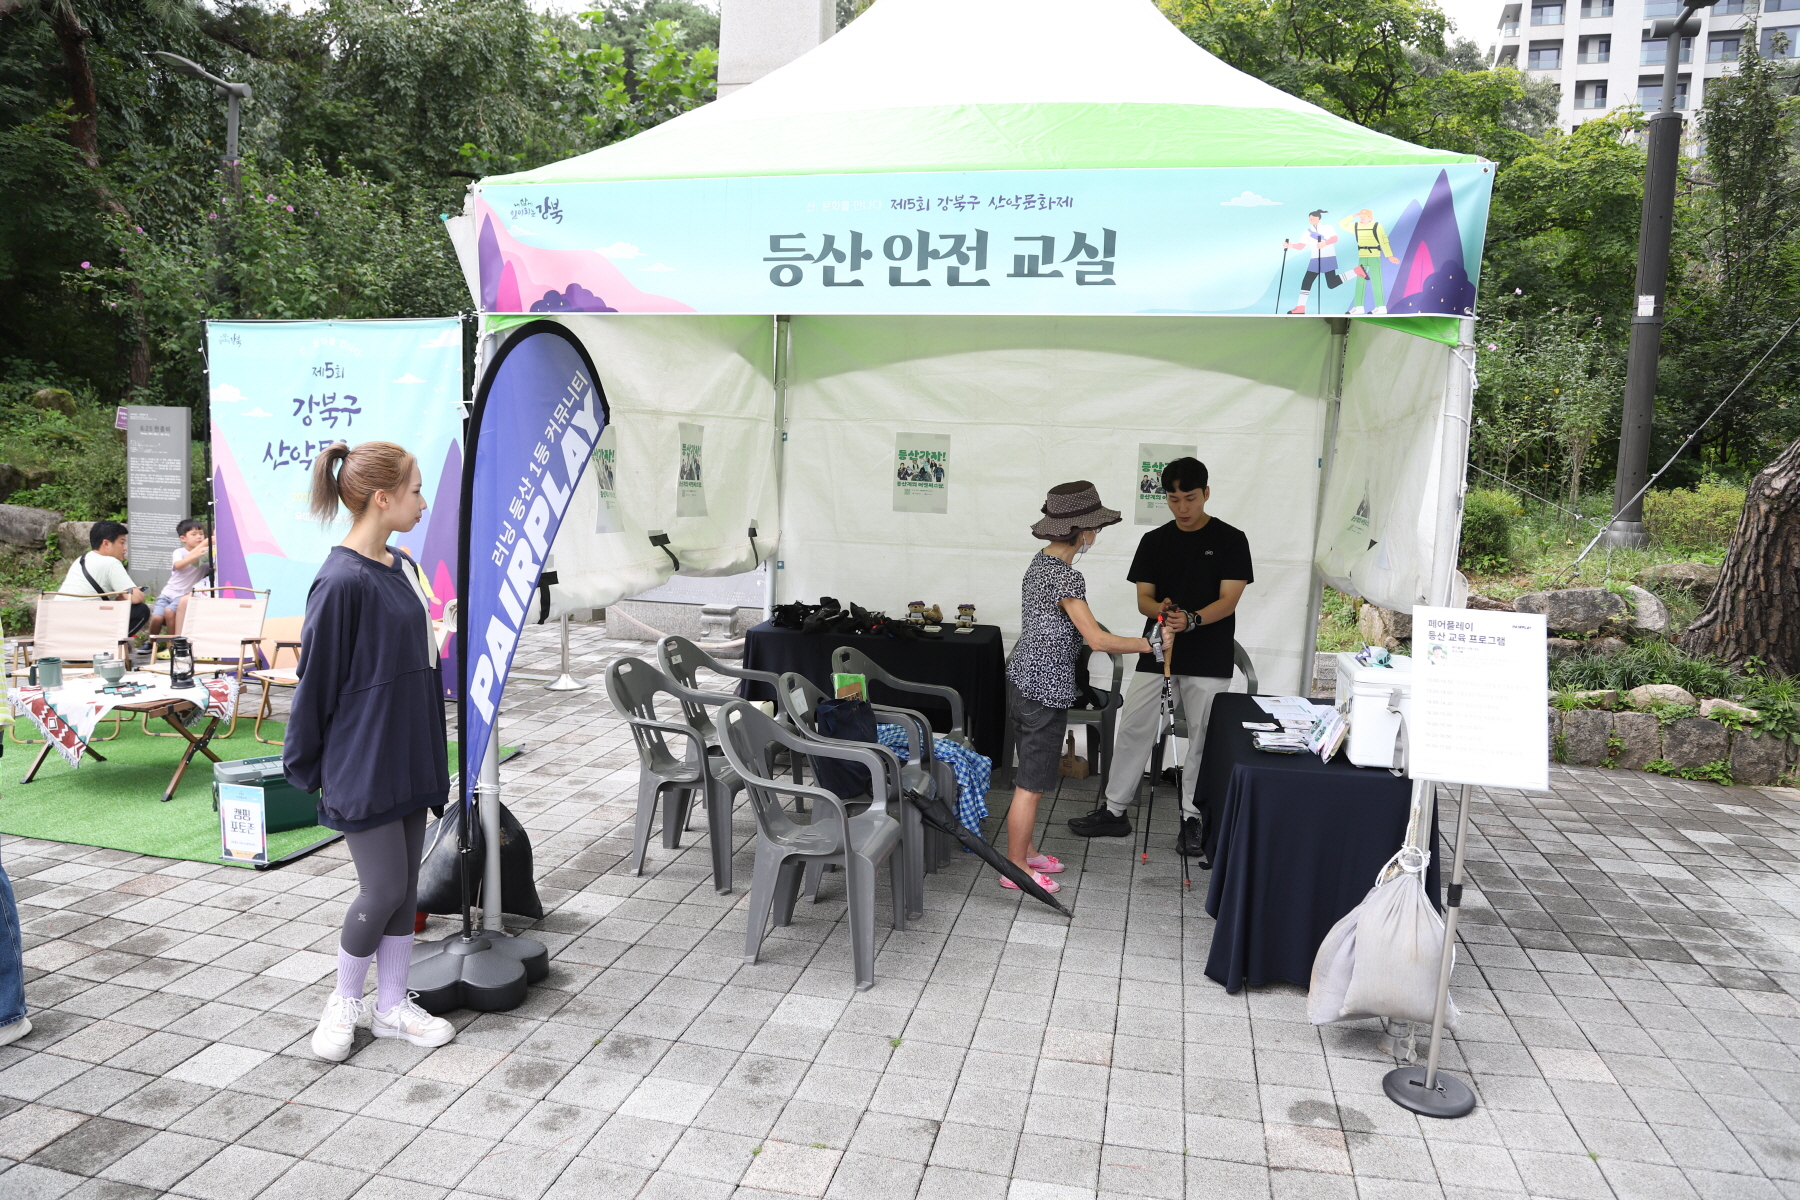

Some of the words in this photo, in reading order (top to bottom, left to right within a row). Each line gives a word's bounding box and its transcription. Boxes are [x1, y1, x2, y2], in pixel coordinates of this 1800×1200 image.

[535, 196, 563, 225] 강북
[937, 194, 981, 212] 강북구
[988, 193, 1073, 211] 산악문화제
[763, 228, 873, 287] 등산
[883, 228, 991, 287] 안전
[1006, 227, 1117, 286] 교실
[311, 361, 345, 379] 제5회
[292, 391, 362, 429] 강북구
[898, 449, 947, 462] 등산가자!
[491, 520, 516, 566] 러닝
[508, 476, 535, 521] 등산
[529, 441, 551, 478] 1등
[544, 370, 588, 443] 커뮤니티
[1141, 461, 1170, 472] 등산
[470, 387, 605, 725] PAIRPLAY
[1427, 619, 1474, 632] 페어플레이
[1427, 631, 1446, 642] 등산
[1448, 633, 1466, 643] 교육
[1469, 634, 1506, 647] 프로그램
[230, 821, 256, 835] 포토존
